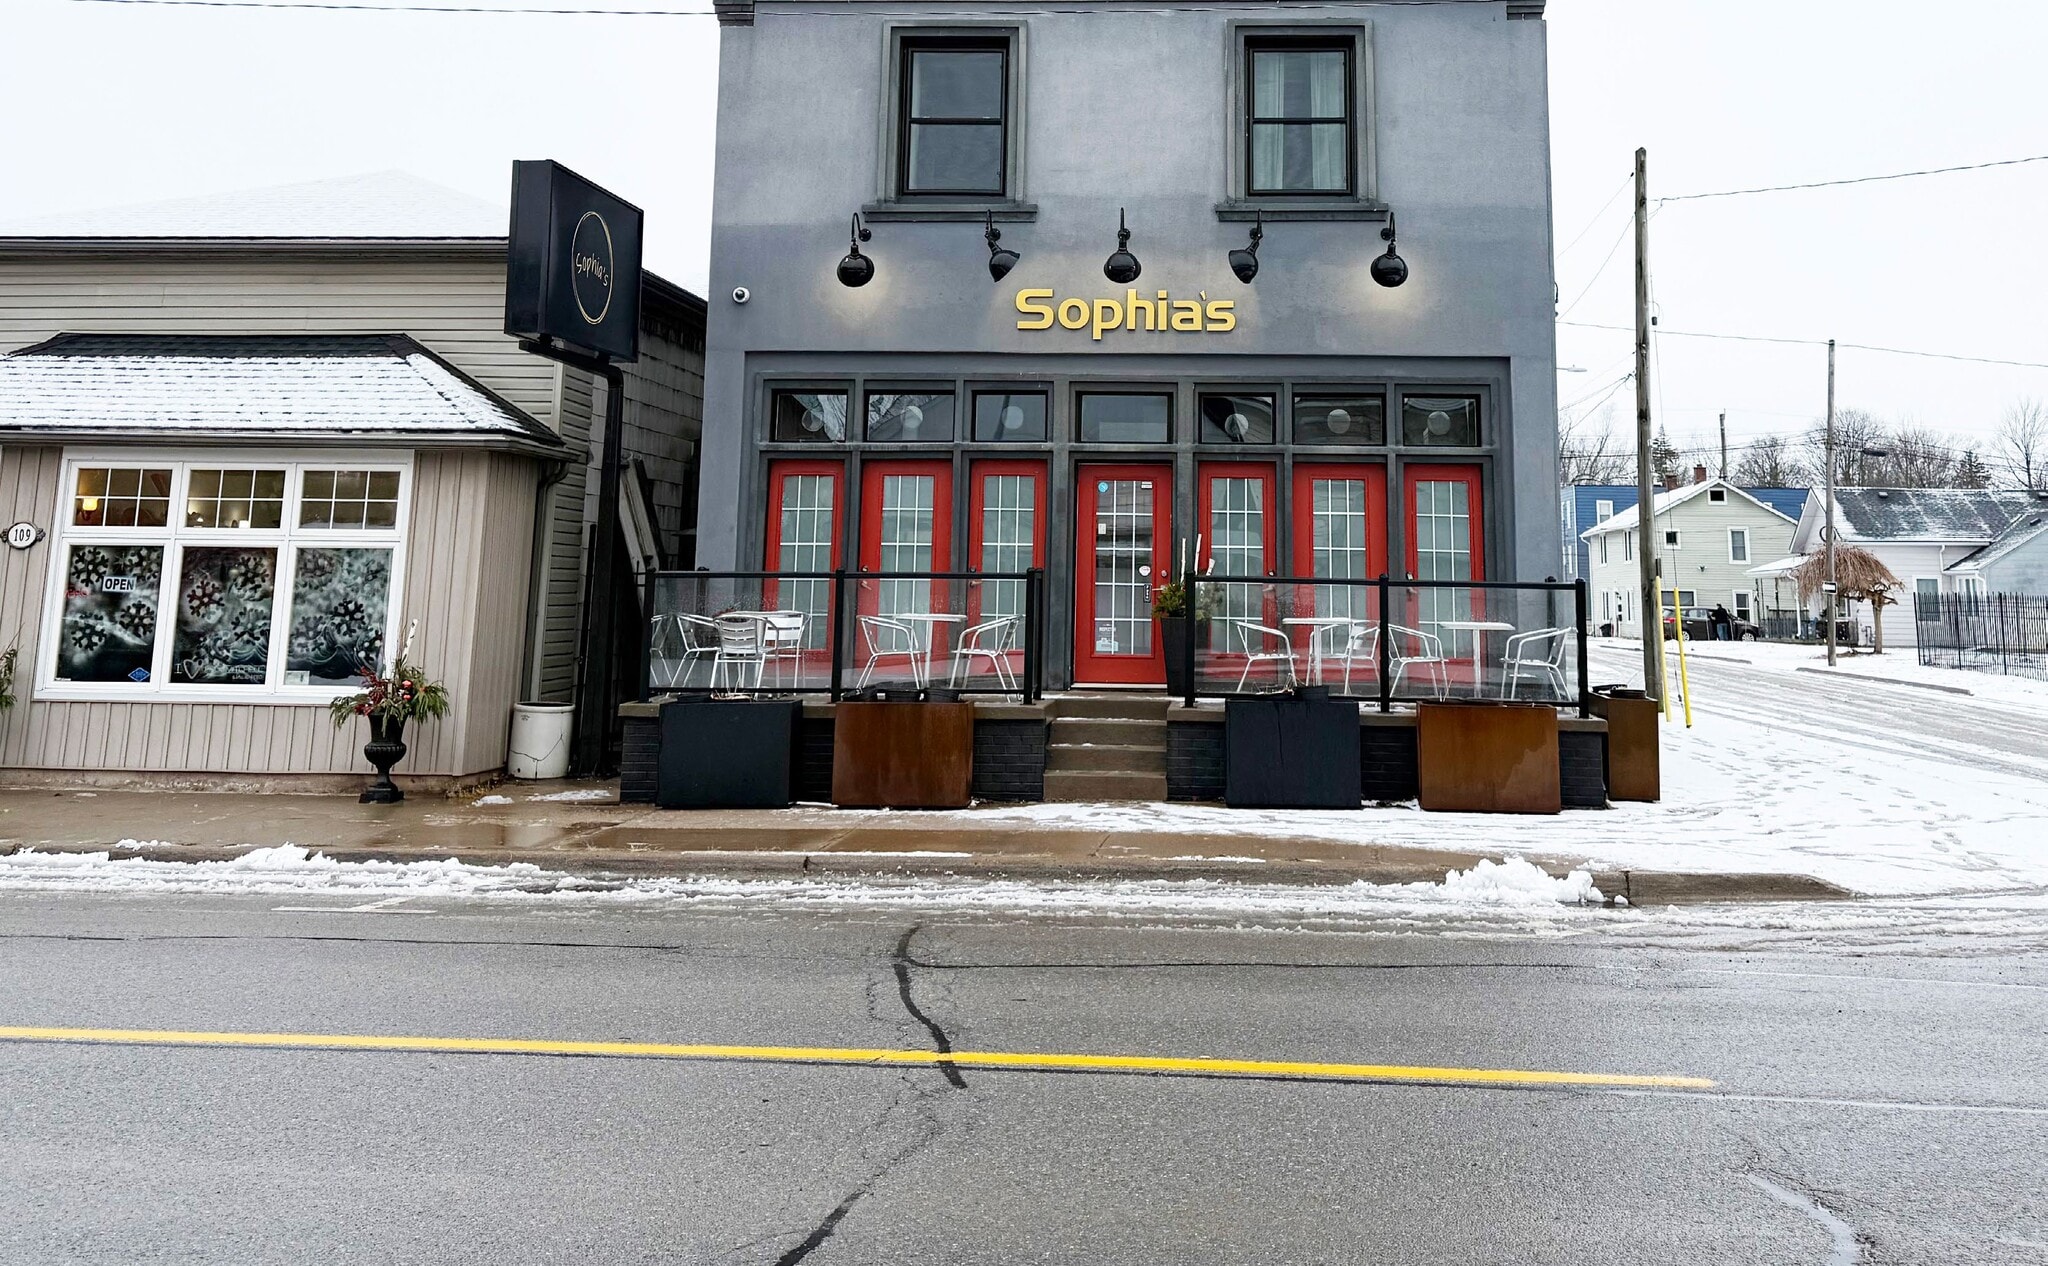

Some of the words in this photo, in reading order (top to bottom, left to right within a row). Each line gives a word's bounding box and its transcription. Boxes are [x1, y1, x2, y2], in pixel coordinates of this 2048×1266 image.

[575, 252, 609, 287] Sophia's
[1014, 288, 1237, 341] Sophia's
[14, 528, 31, 542] 109
[104, 578, 135, 591] OPEN
